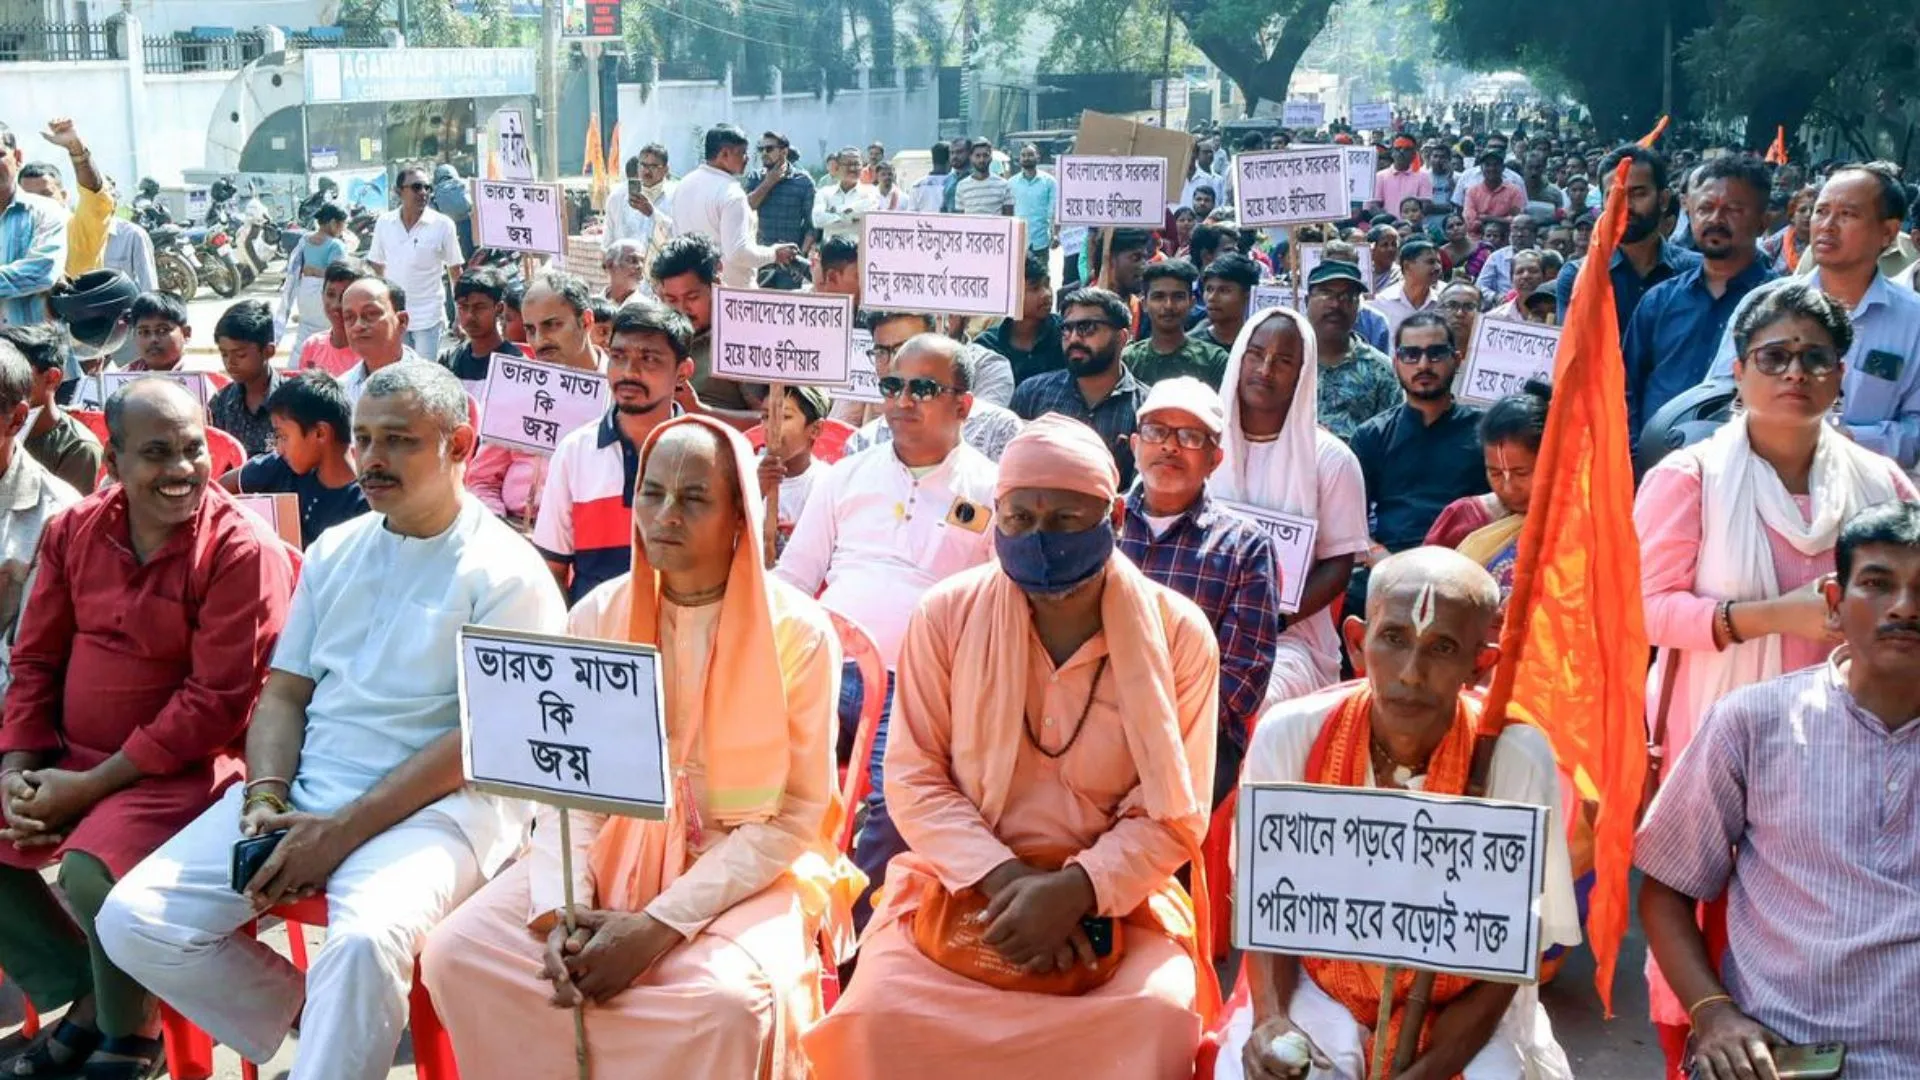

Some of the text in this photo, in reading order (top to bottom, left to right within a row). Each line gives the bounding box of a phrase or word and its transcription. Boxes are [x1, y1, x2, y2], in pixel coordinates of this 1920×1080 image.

[342, 50, 531, 78] AGARTALA SMART CITY
[1066, 163, 1160, 181] বাংলাদেশের সরকার
[1243, 154, 1341, 181] বাংলাদেশের সরকার
[1348, 151, 1370, 165] রকার
[483, 184, 550, 205] ভারত মাতা
[1066, 191, 1143, 219] হয়ে যাও হুঁশিয়ার
[1246, 187, 1326, 217] হয়ে যাও হুঁশিয়ার
[509, 203, 525, 223] কি
[506, 225, 533, 246] জয়
[868, 220, 1006, 260] মোহাম্মদ ইউনুসের সরকার
[867, 262, 990, 301] হিন্দু রক্ষায় ব্যর্থ বারবার
[724, 298, 844, 329] বাংলাদেশের সরকার
[724, 341, 746, 367] হয়ে
[748, 344, 772, 368] যাও
[774, 338, 821, 372] হুঁশিয়ার
[1486, 326, 1558, 359] বাংলাদেশের
[501, 361, 601, 399] ভারত মাতা
[1476, 368, 1501, 393] হয়ে
[533, 389, 556, 415] কি
[522, 415, 561, 445] জয়
[474, 645, 640, 698] ভারত মাতা
[536, 689, 576, 736] কি
[526, 738, 592, 789] জয়
[1258, 807, 1527, 882] যেখানে পড়বে হিন্দুর রক্ত
[1256, 876, 1511, 954] পরিণাম হবে বড়োই শক্ত
